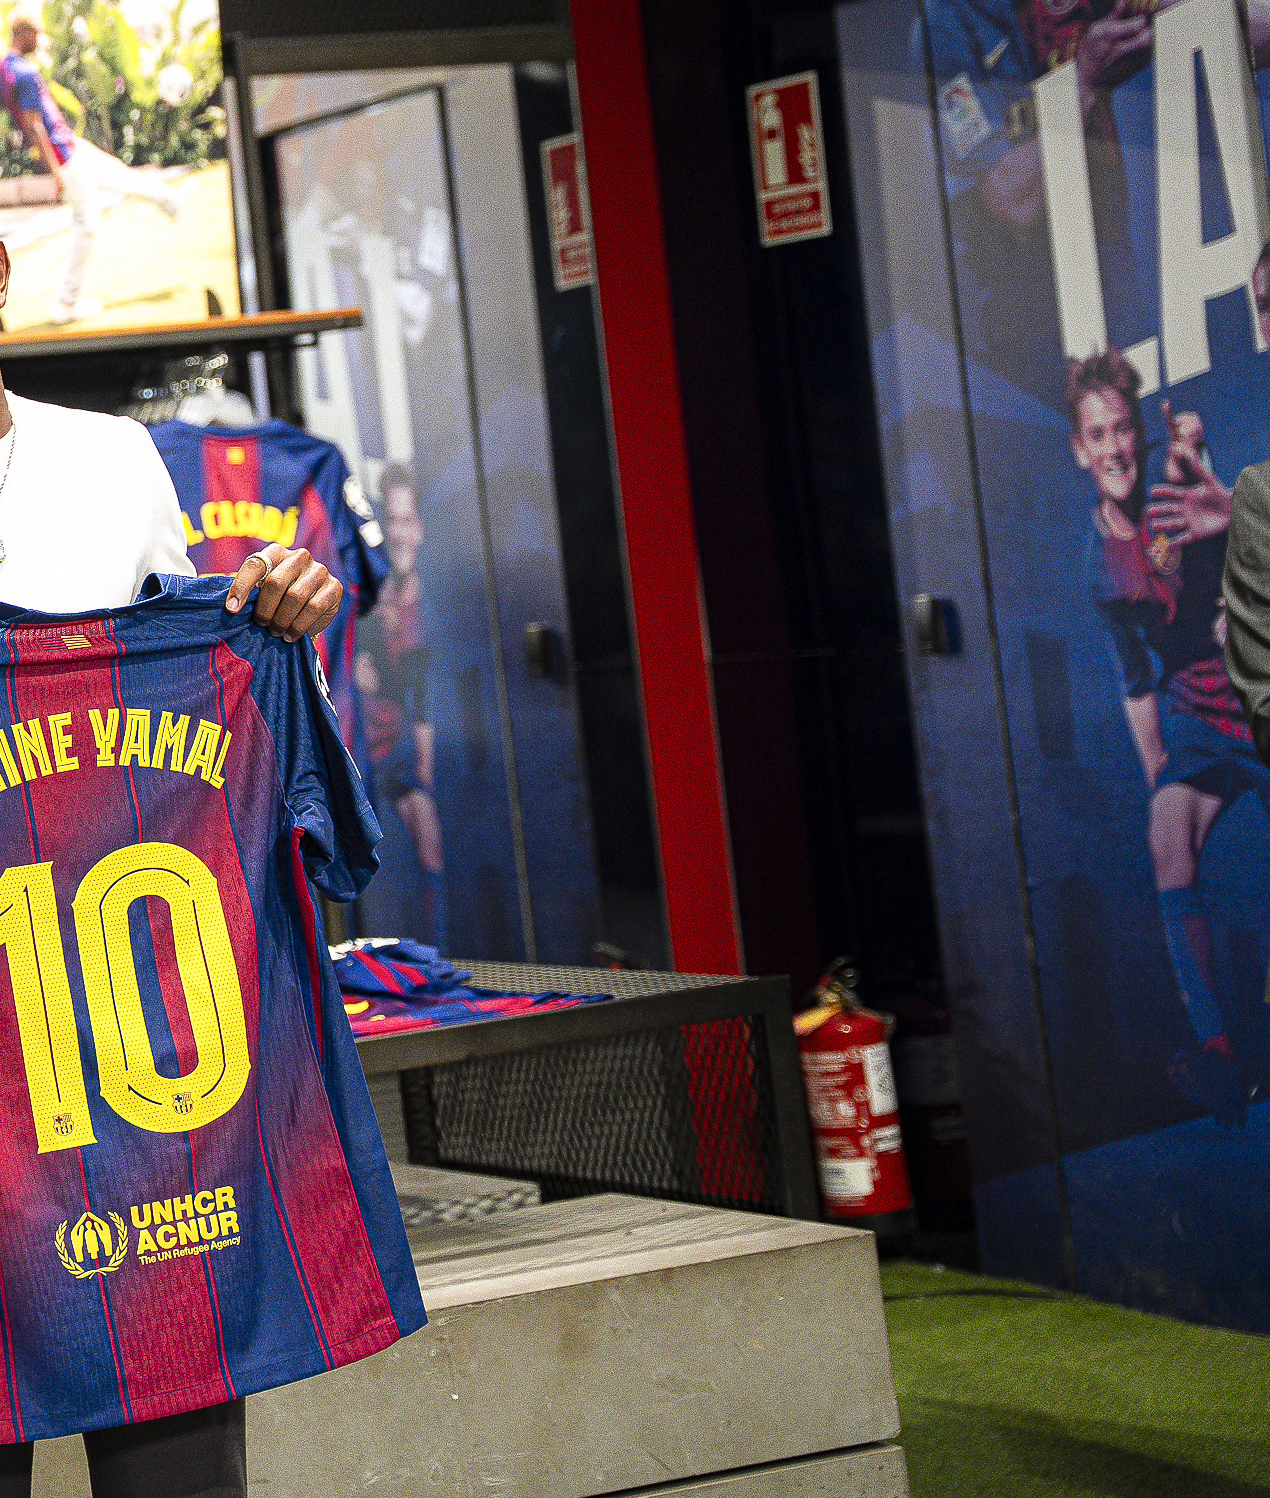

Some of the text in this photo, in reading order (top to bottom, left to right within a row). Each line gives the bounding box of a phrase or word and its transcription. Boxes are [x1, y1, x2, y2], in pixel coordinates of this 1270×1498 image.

[87, 707, 233, 790] YAMAL
[130, 1186, 237, 1229] UNHCR
[137, 1210, 240, 1256] ACNUR
[138, 1236, 241, 1265] The UN Refugee Agency
